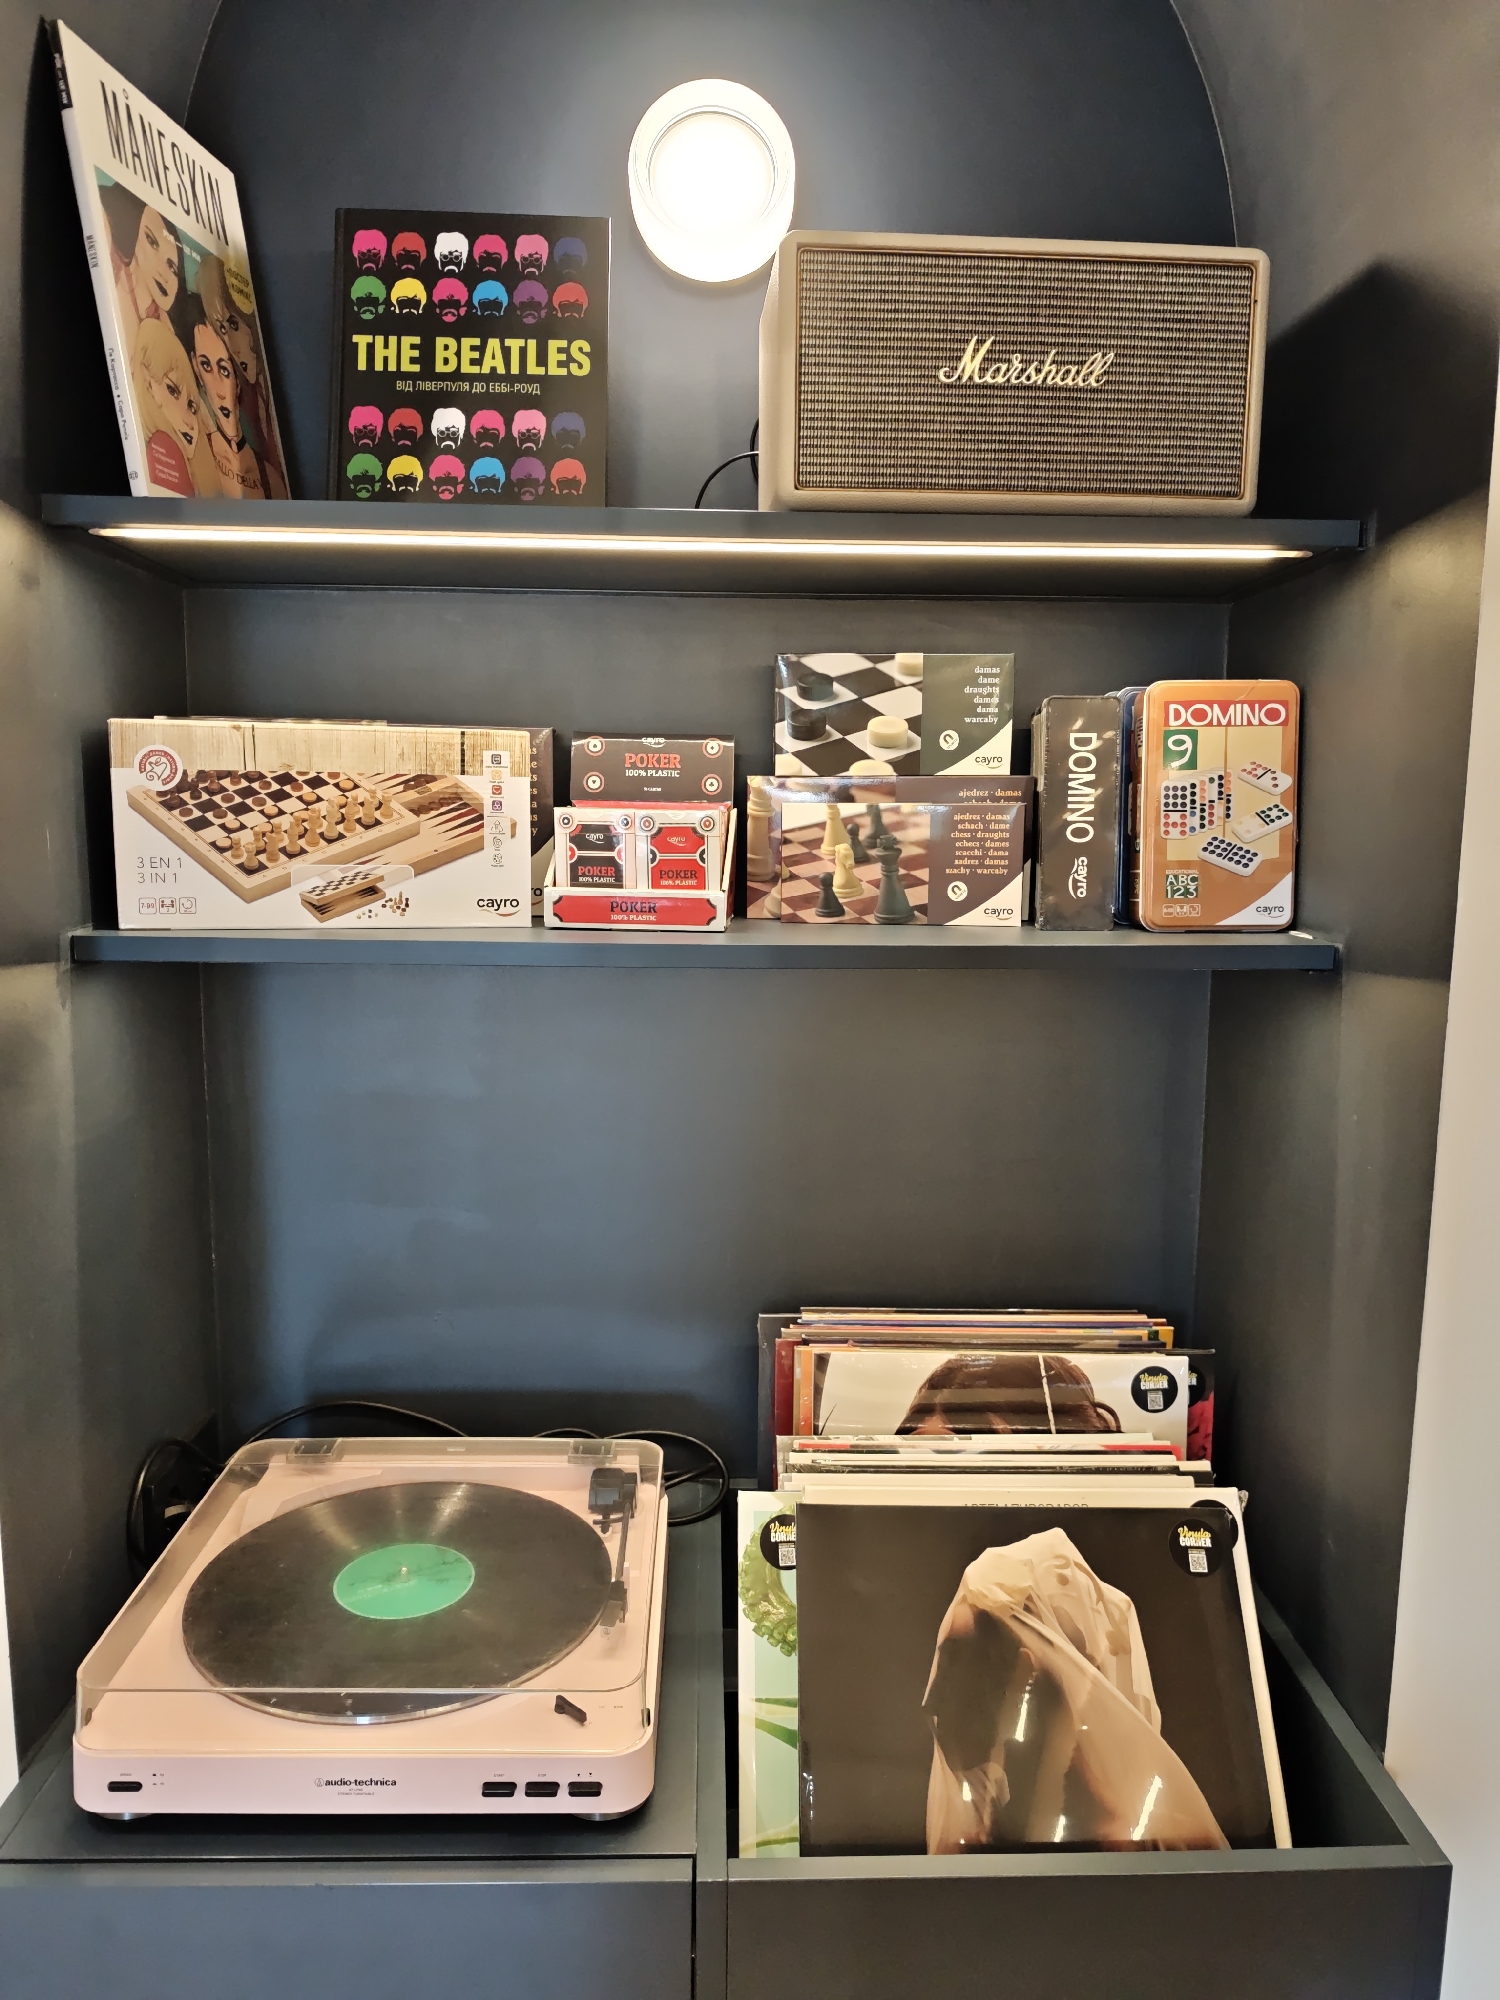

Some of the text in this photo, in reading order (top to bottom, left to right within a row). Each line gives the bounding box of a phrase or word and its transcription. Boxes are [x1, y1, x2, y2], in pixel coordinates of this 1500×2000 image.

[99, 79, 229, 247] MÅNESKIN
[352, 335, 591, 376] THE BEATLES
[938, 335, 1115, 387] Marshall
[396, 380, 540, 395] ВІД ЛІВЕРПУЛЯ ДО ЕББІ-РОУД
[974, 666, 1001, 674] damas
[977, 675, 1000, 684] dame
[964, 685, 1000, 695] draughts
[974, 695, 1000, 704] dames
[976, 705, 999, 713] dama
[964, 714, 999, 725] warcaby
[1168, 703, 1286, 727] DOMINO
[1167, 734, 1194, 768] 9
[624, 753, 682, 769] POKER
[975, 756, 1003, 765] cayro
[625, 769, 681, 777] 100% PLASTIC
[1066, 732, 1098, 843] DOMINO
[958, 789, 1022, 798] ajedrez damas
[986, 812, 1011, 820] damas
[957, 822, 1011, 830] schach dame
[976, 831, 1010, 839] draughts
[985, 840, 1010, 848] dames
[136, 856, 182, 868] 3 EN 1
[984, 857, 1009, 865] damas
[578, 866, 616, 876] POKER
[659, 869, 698, 879] POKER
[976, 867, 1009, 876] warcaby
[137, 872, 146, 884] 3
[150, 872, 166, 884] IN
[1073, 856, 1088, 898] cayro
[1166, 874, 1199, 886] ABC
[1166, 885, 1197, 899] 123
[476, 898, 520, 912] cayro
[610, 901, 658, 914] POKER
[1255, 905, 1285, 915] cayro
[983, 907, 1014, 917] cayro
[771, 1532, 796, 1542] CORNE
[1180, 1537, 1213, 1548] CORNER
[324, 1778, 397, 1787] audio-technica
